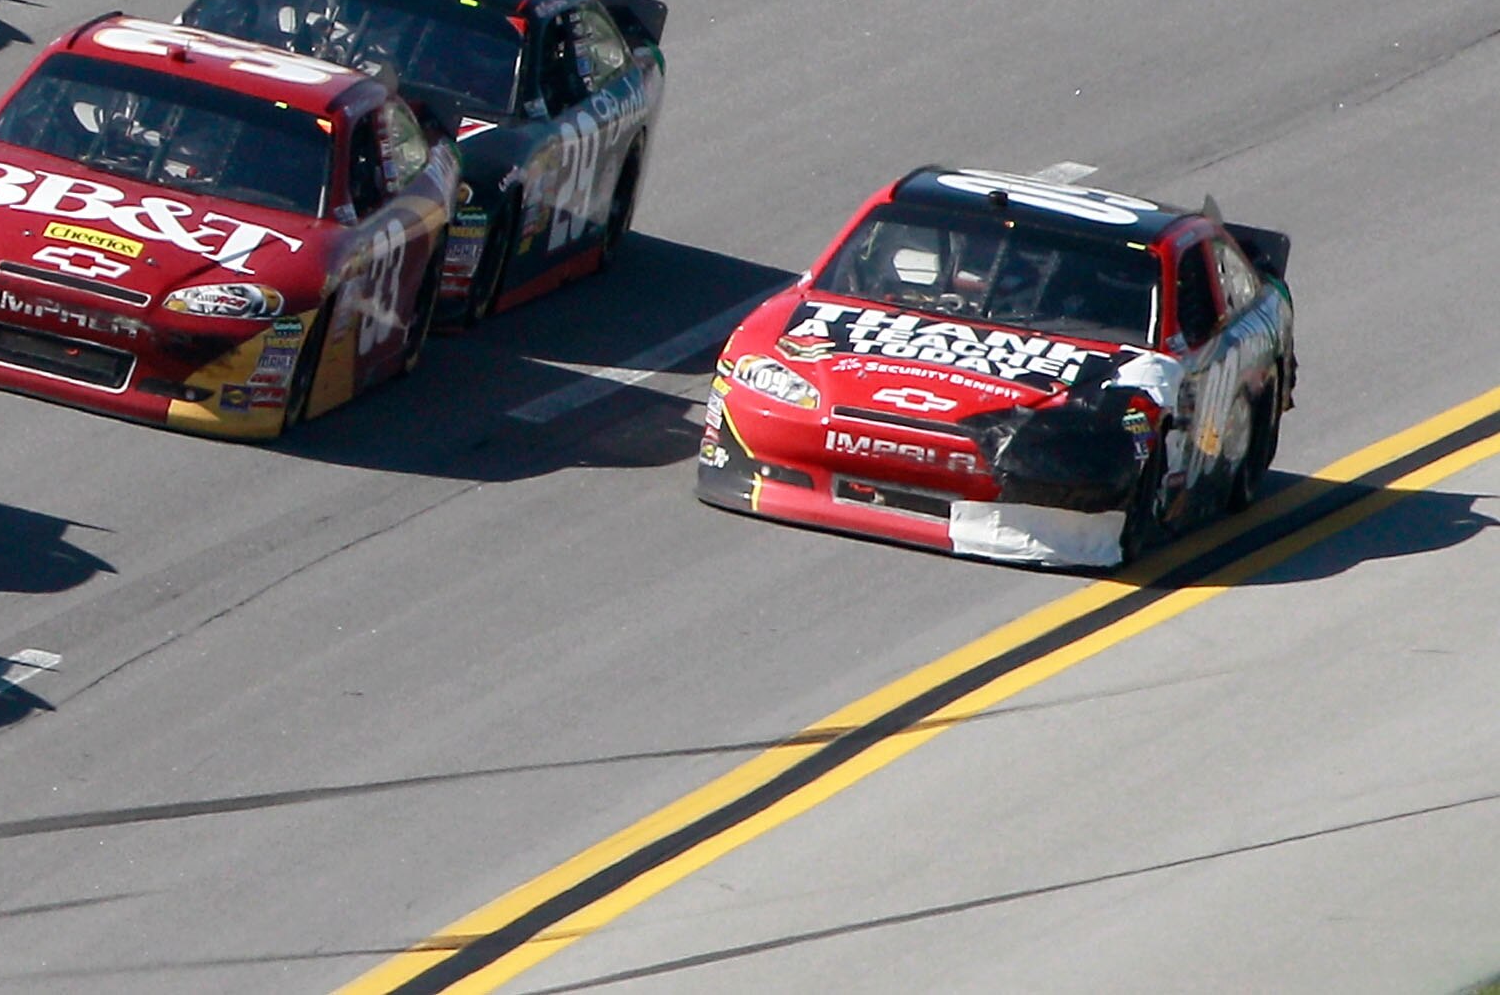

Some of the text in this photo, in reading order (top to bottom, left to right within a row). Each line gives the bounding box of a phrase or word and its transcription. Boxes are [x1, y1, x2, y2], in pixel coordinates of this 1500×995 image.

[49, 224, 137, 254] Cheerios
[788, 318, 830, 338] A
[806, 300, 1111, 363] THANK
[851, 339, 1030, 380] TODAY
[754, 367, 790, 397] 09
[864, 361, 1021, 400] SECURITY BENEFIT
